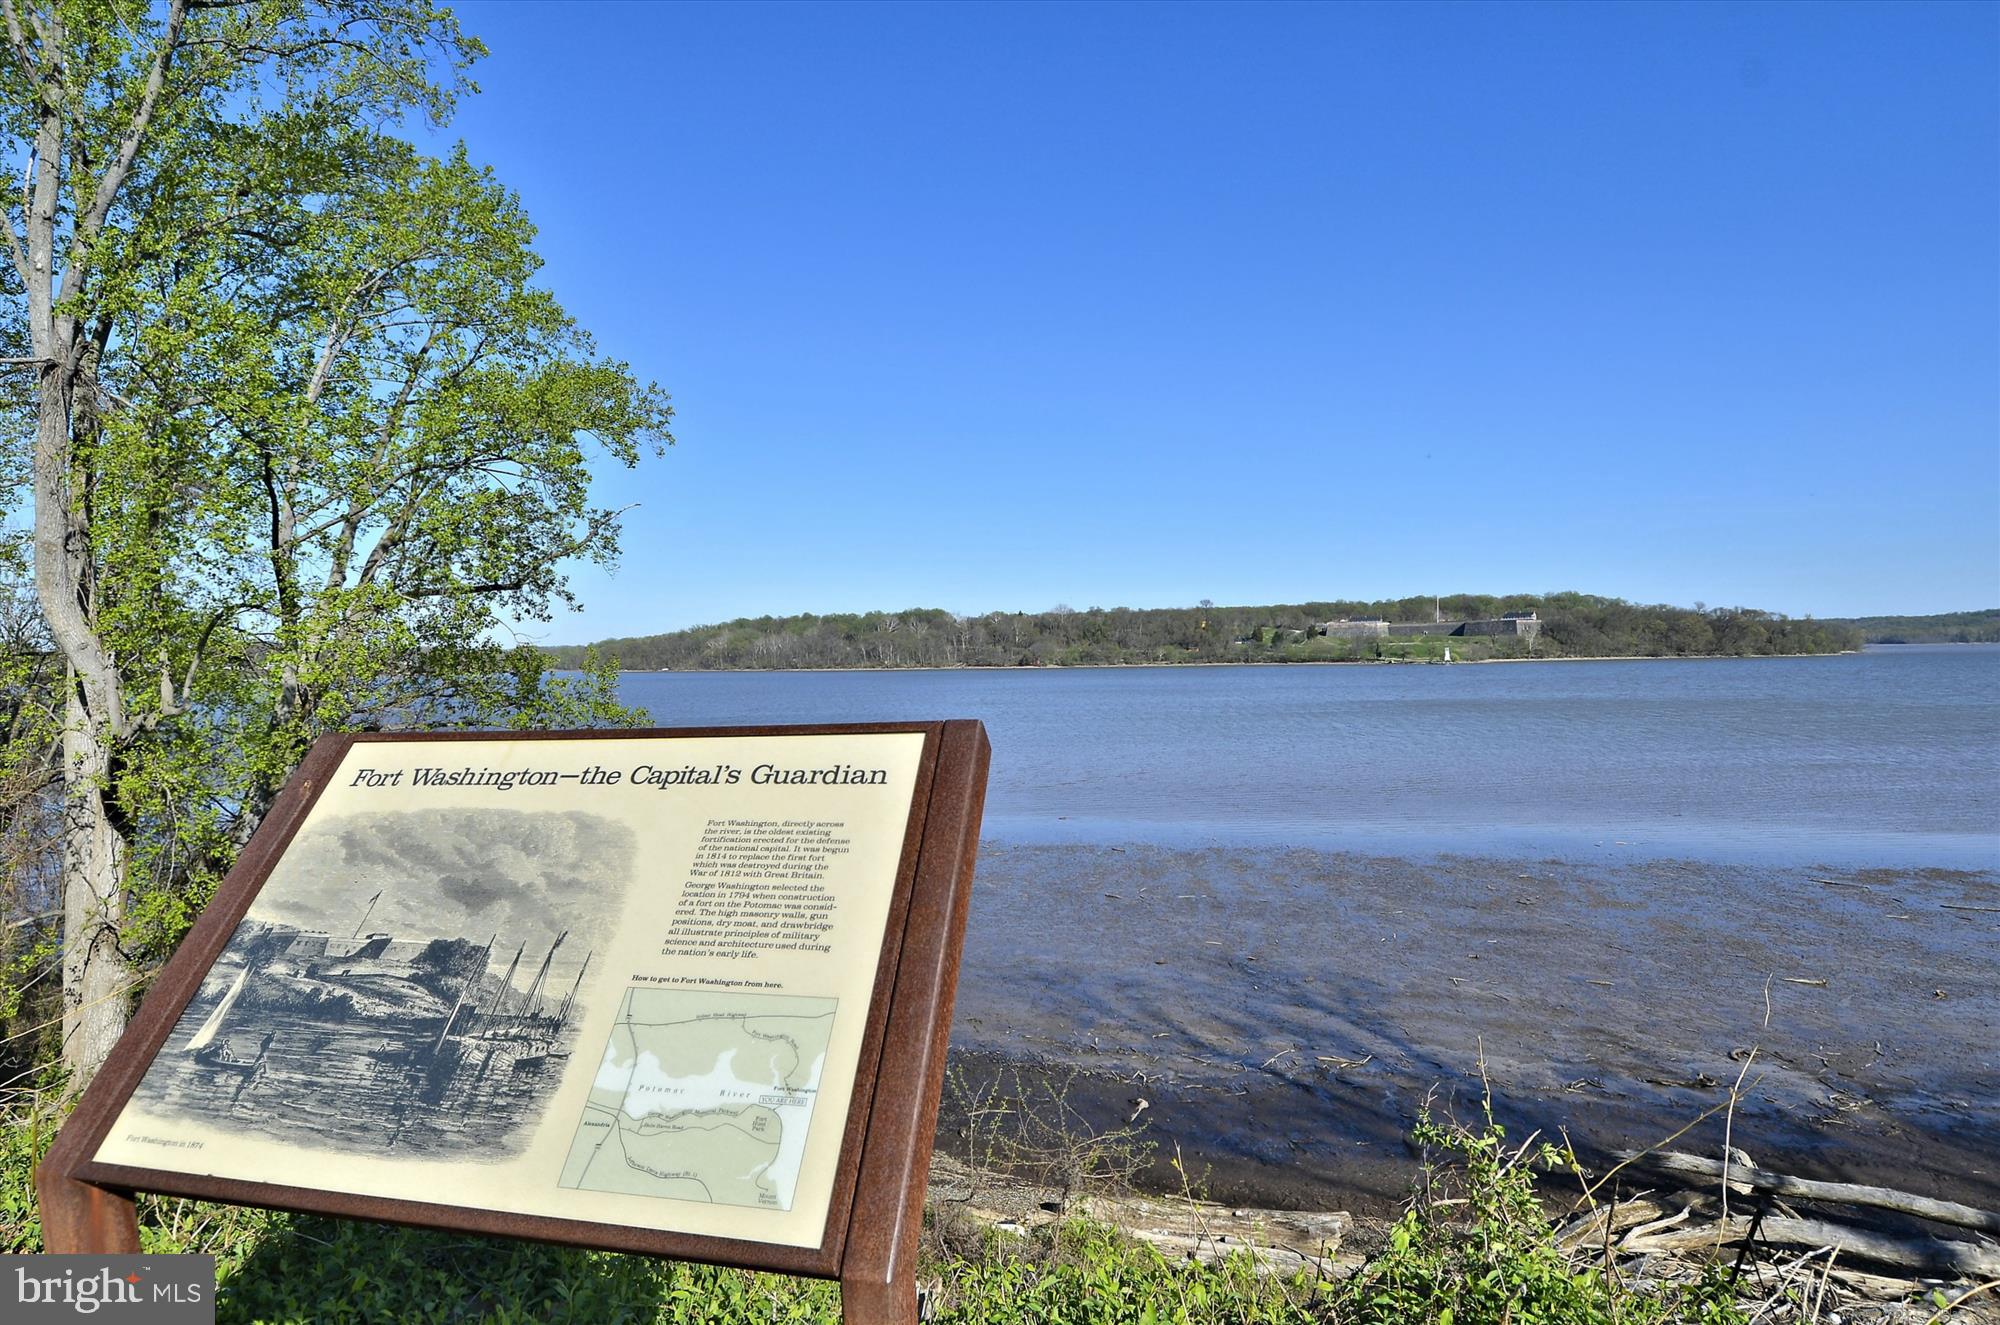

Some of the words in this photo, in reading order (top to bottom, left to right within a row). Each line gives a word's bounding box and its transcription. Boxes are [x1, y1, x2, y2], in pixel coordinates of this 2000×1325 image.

[348, 768, 404, 788] Fort
[751, 764, 888, 786] Guardian
[728, 820, 780, 828] Washington,
[782, 820, 815, 828] directly
[738, 862, 781, 870] destroyed
[783, 863, 812, 871] during
[791, 871, 824, 879] Britain.
[685, 882, 715, 890] George
[717, 882, 770, 891] Washington
[772, 884, 808, 892] selected
[729, 891, 750, 899] 1794
[778, 893, 835, 901] construction
[743, 901, 782, 909] Potomac
[718, 909, 738, 918] high
[740, 911, 780, 919] masonry
[782, 911, 807, 919] walls,
[671, 919, 714, 928] positions,
[716, 919, 732, 928] dry
[780, 922, 833, 930] drawbridge
[681, 928, 723, 936] illustrate
[723, 930, 769, 939] principles
[782, 931, 820, 941] military
[665, 938, 697, 946] science
[717, 940, 774, 949] architecture
[798, 942, 831, 952] during
[716, 950, 739, 959] early
[658, 976, 670, 984] get
[698, 978, 743, 987] Washington
[638, 1085, 686, 1094] Potomac
[719, 1090, 752, 1098] River
